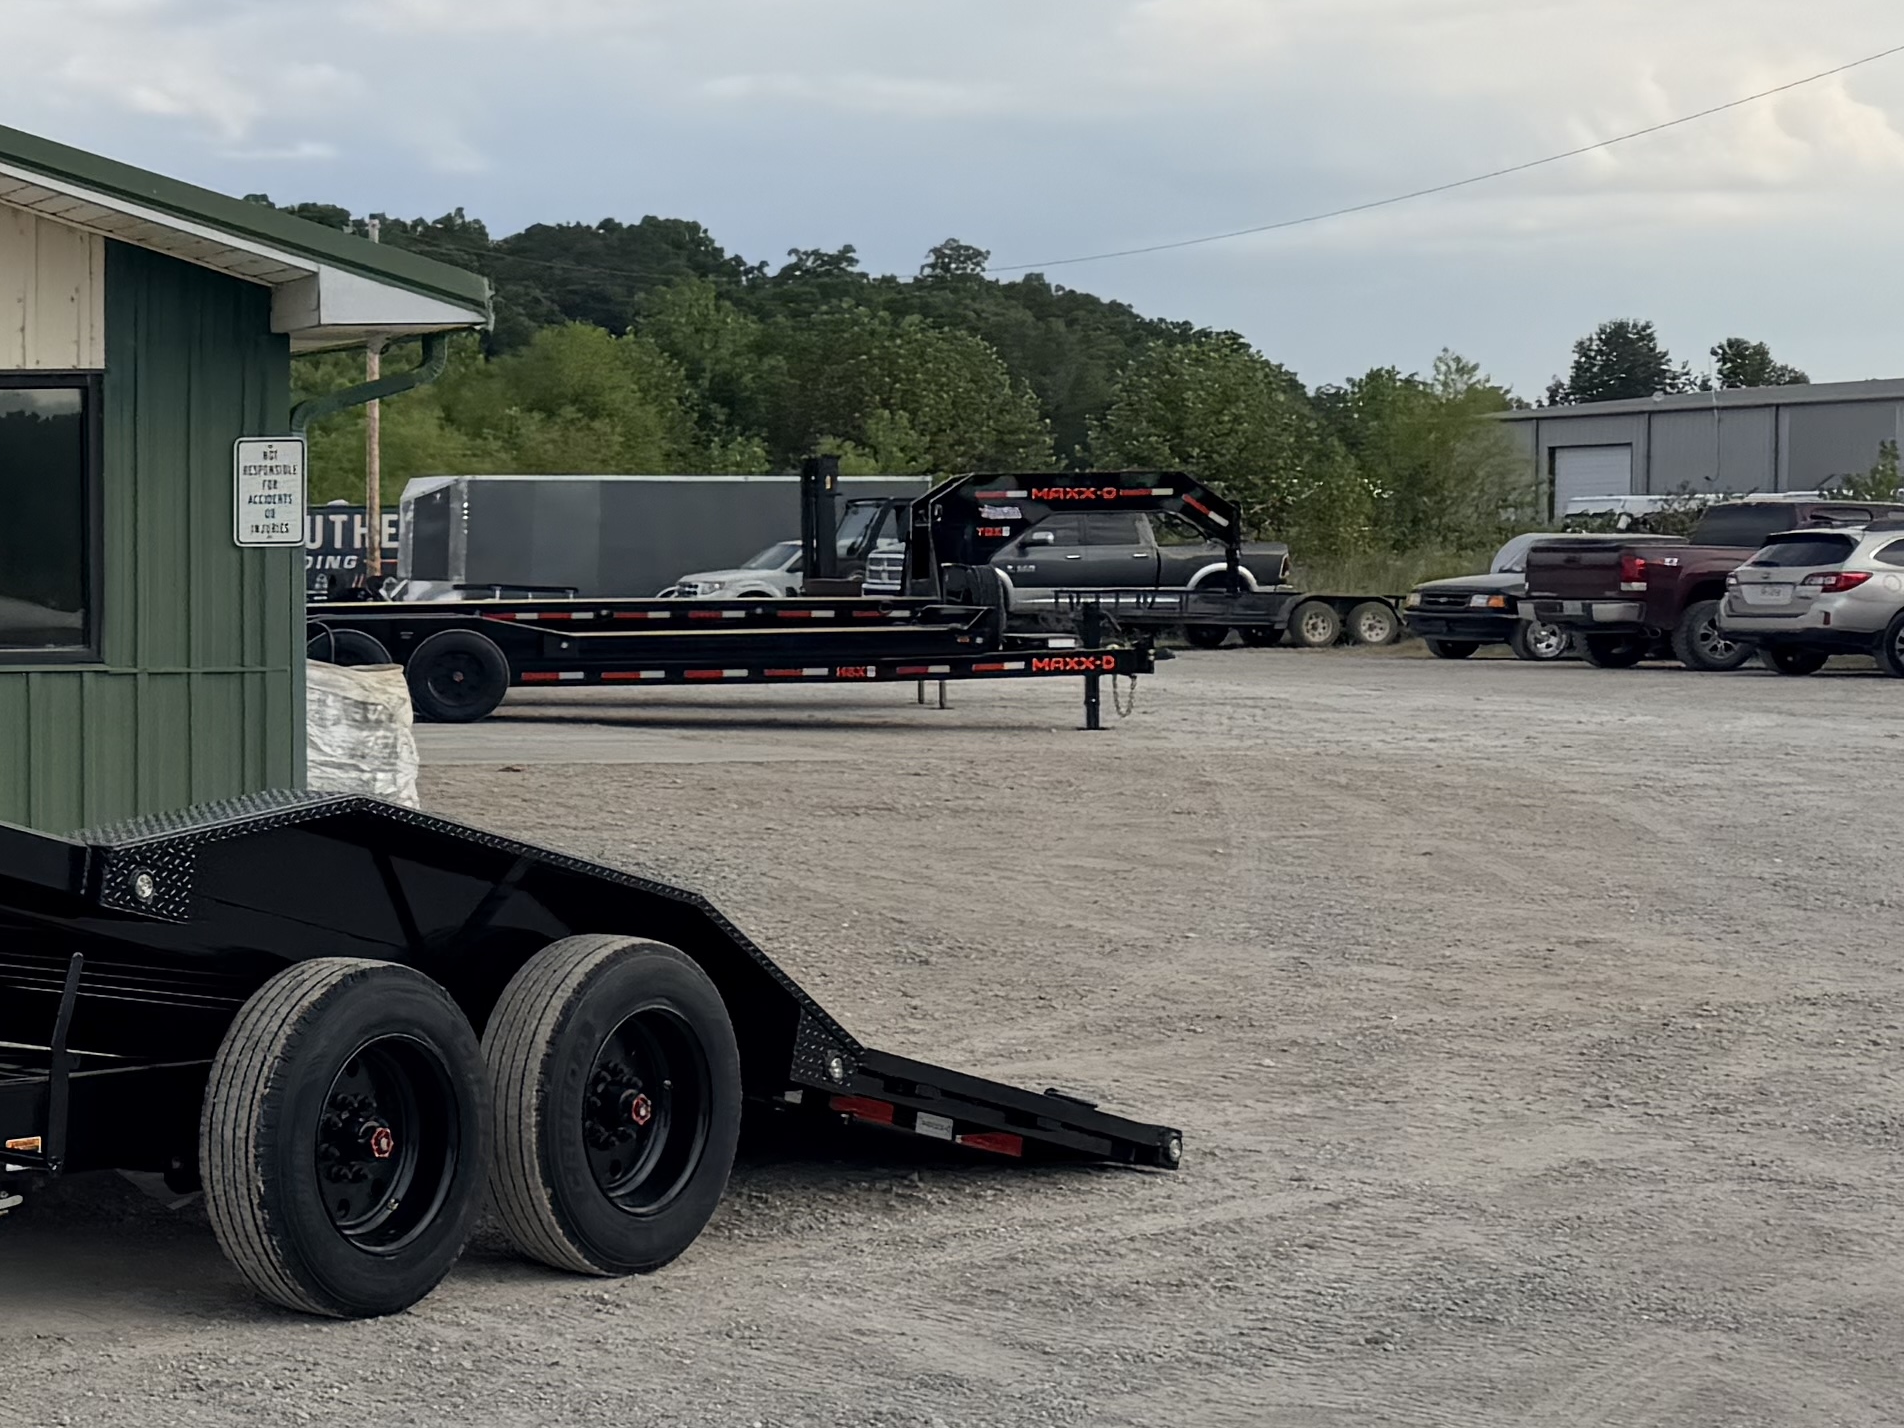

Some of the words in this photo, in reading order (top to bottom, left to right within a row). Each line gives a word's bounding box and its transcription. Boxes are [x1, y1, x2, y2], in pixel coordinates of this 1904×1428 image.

[248, 494, 293, 504] ACCIDENTS
[1032, 487, 1117, 500] MAXX-D
[1032, 656, 1115, 671] MAXX-D
